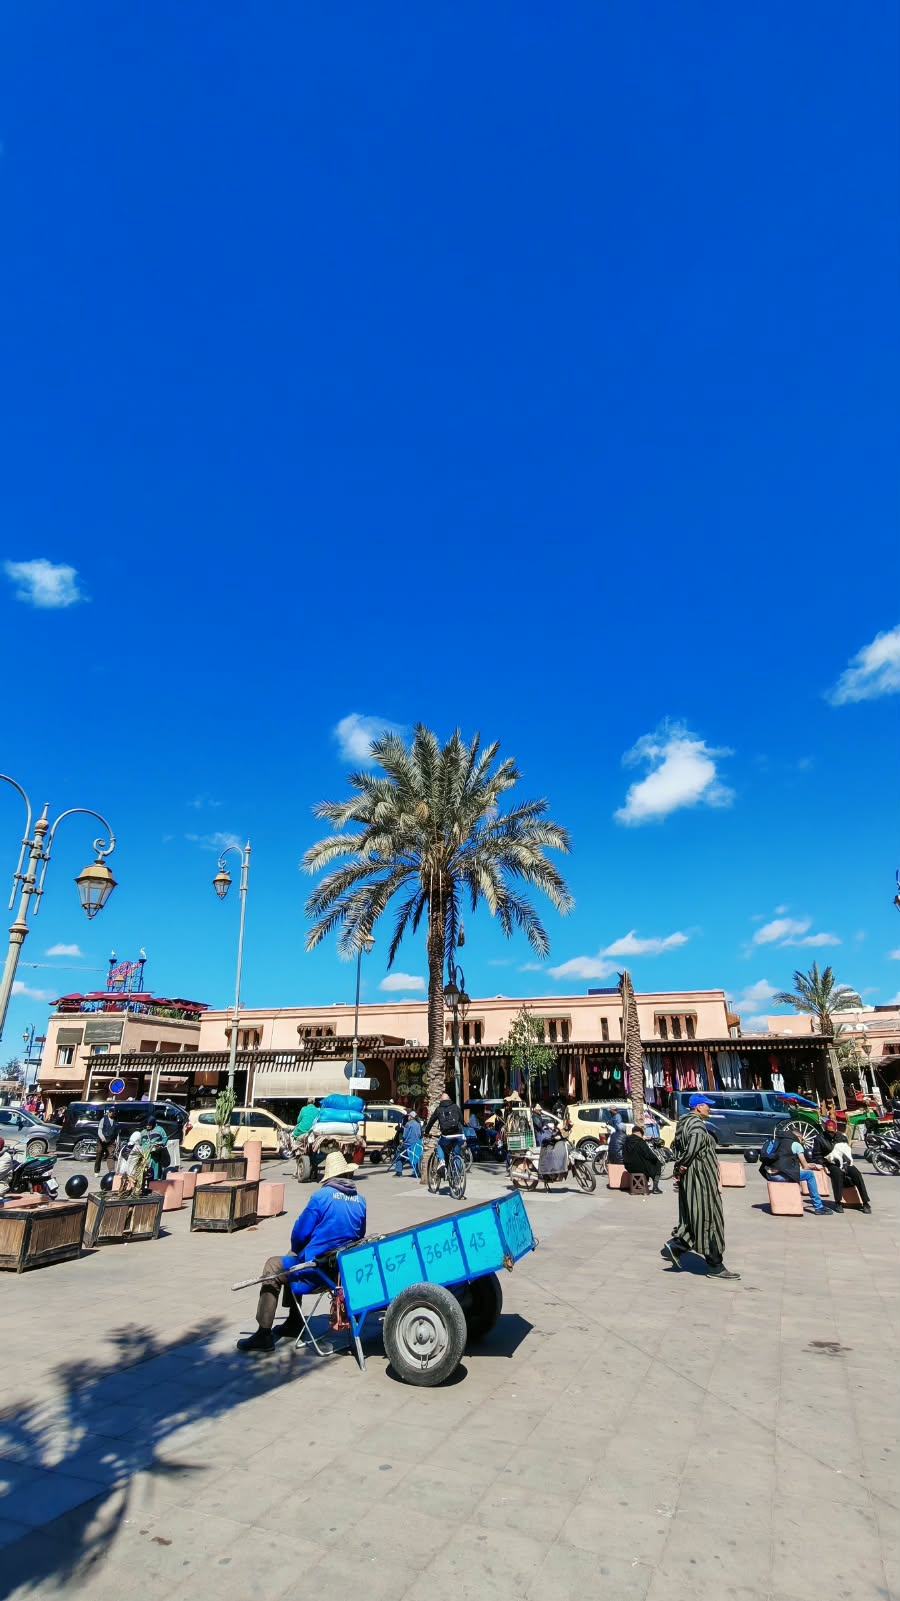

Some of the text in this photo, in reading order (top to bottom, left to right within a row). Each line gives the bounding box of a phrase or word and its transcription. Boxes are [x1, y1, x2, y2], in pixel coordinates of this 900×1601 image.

[356, 1264, 373, 1284] 07
[386, 1254, 406, 1272] 67
[424, 1239, 458, 1264] 3645
